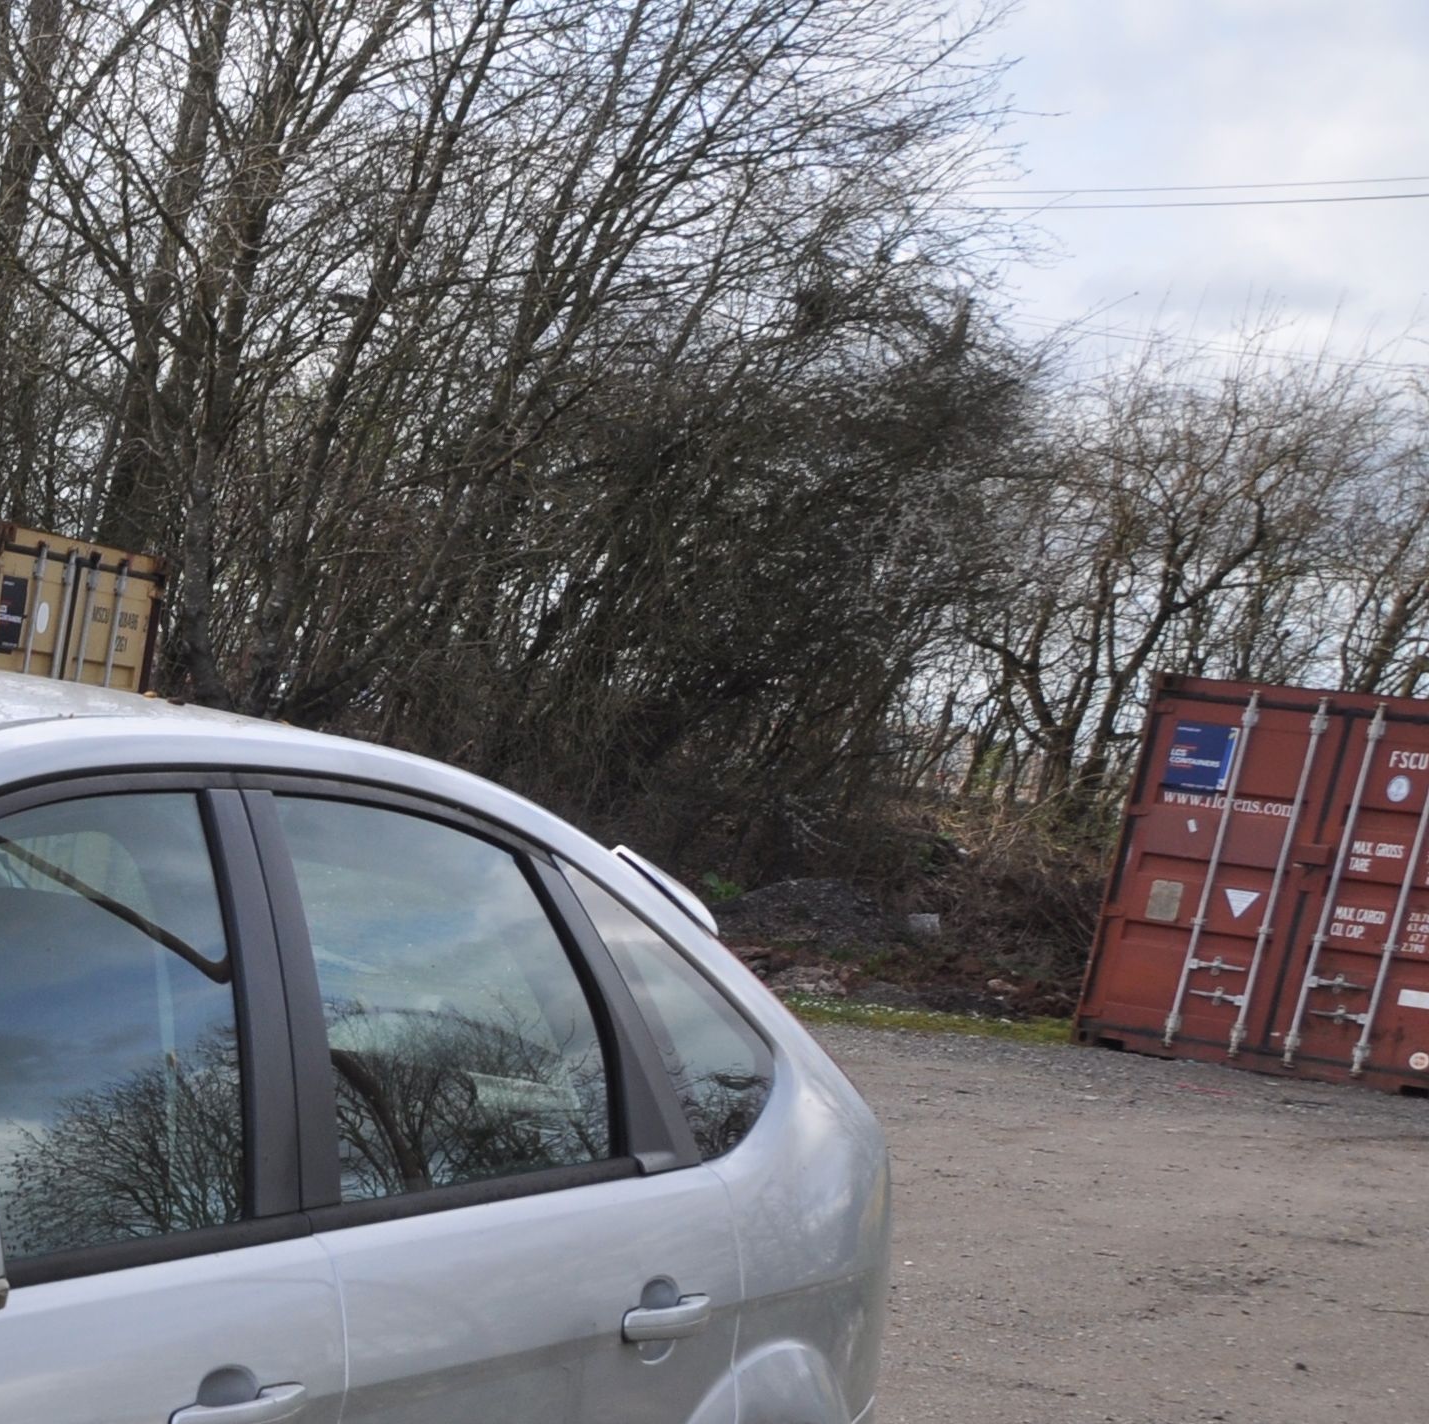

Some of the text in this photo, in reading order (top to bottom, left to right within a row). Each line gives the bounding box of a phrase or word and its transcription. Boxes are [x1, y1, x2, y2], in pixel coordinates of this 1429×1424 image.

[1171, 748, 1188, 757] LCS
[1389, 750, 1428, 770] FSCU
[1169, 757, 1220, 769] CONTAINERS
[1375, 843, 1405, 858] GROSS
[1349, 857, 1372, 872] TARE
[1356, 908, 1387, 924] CARGO
